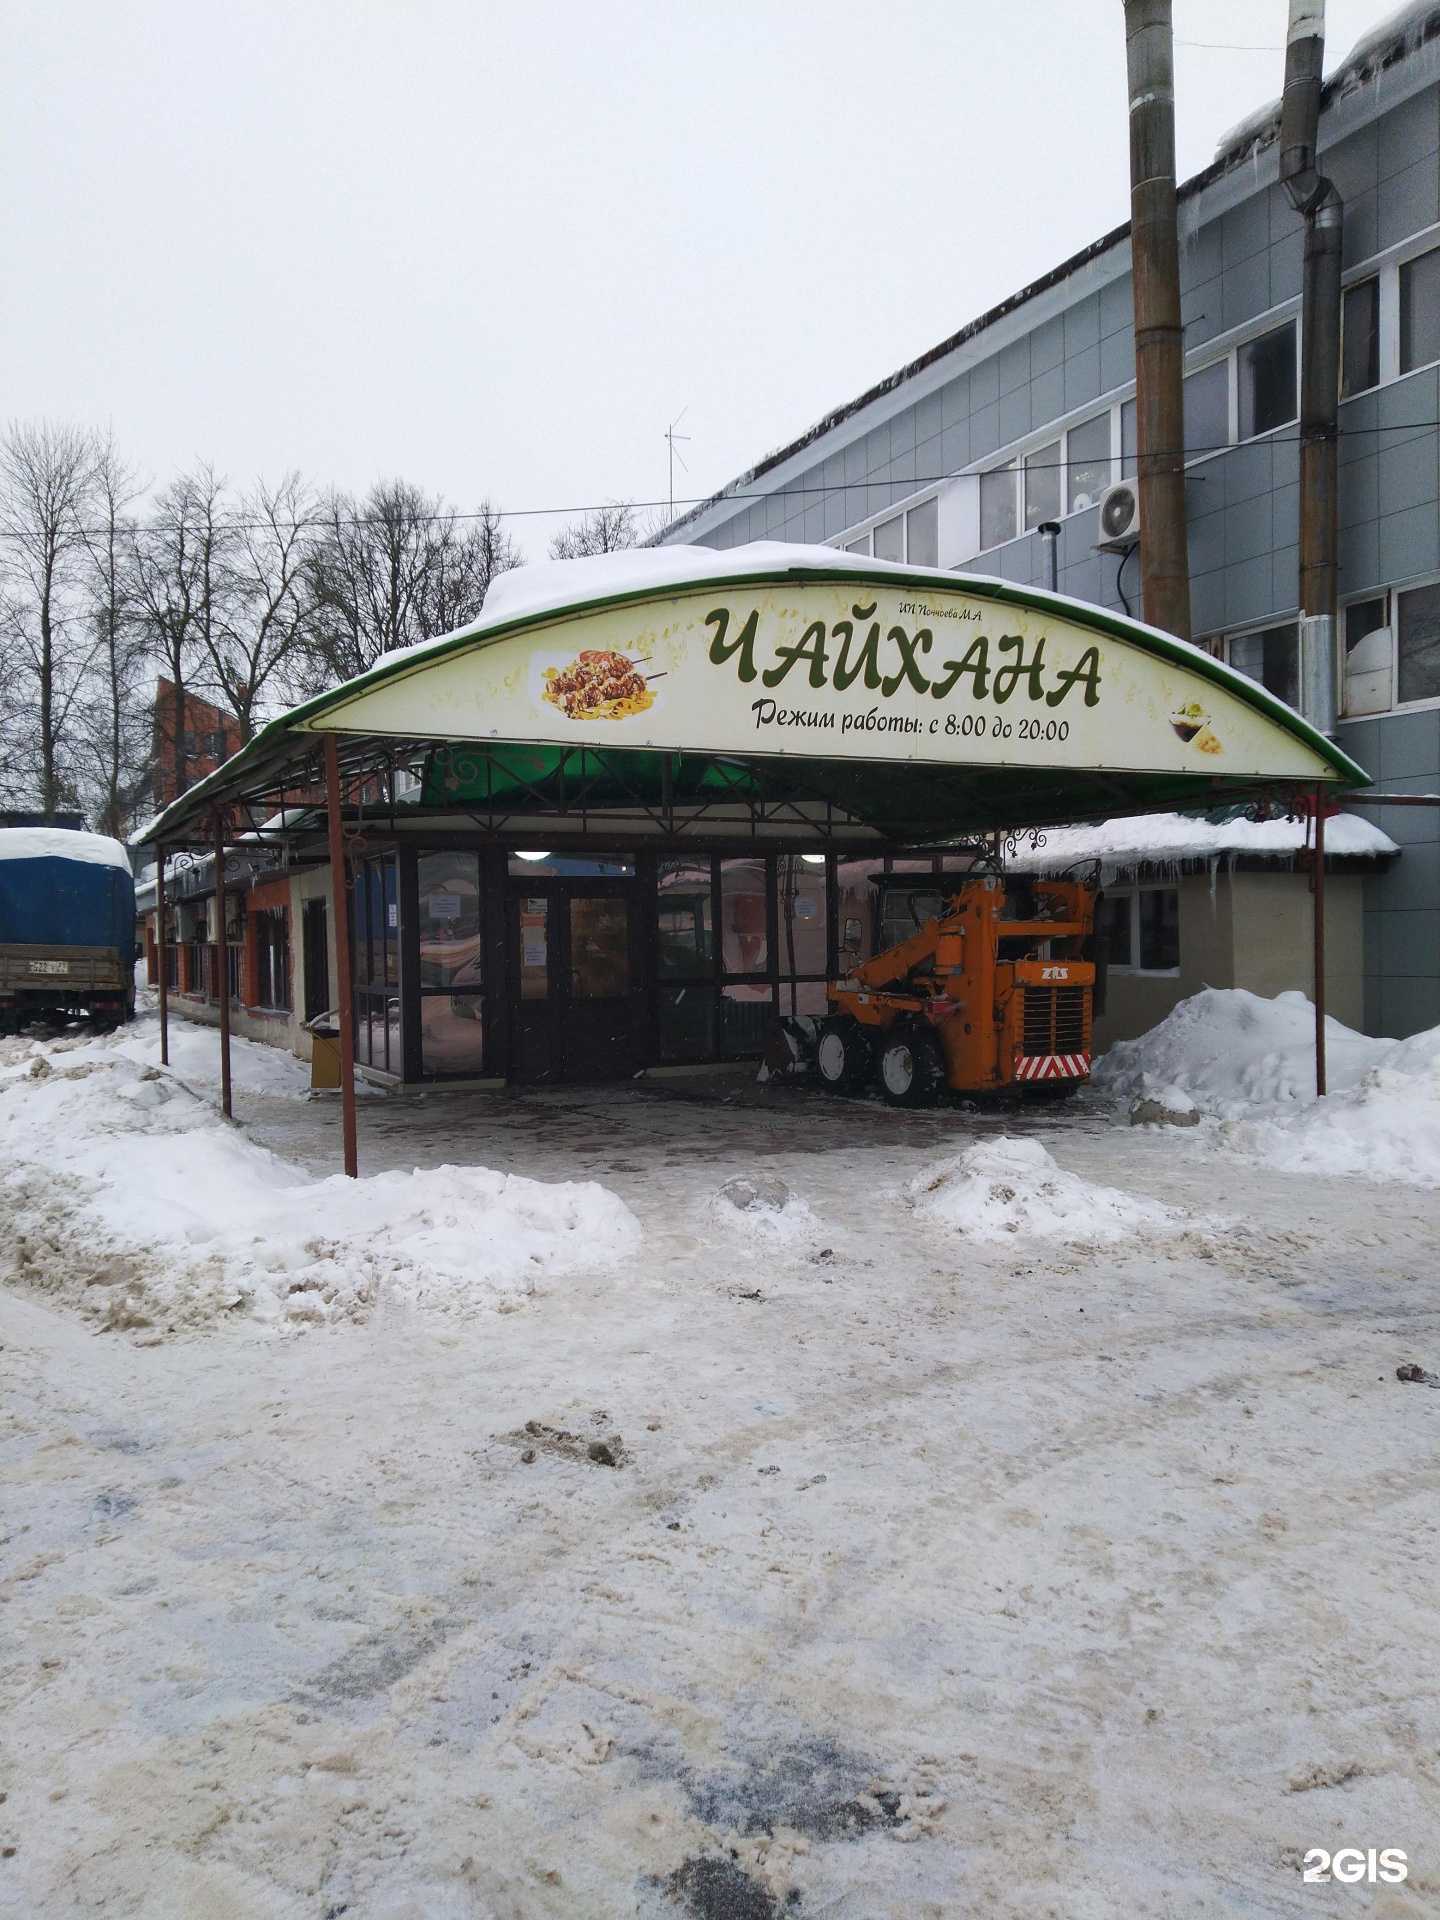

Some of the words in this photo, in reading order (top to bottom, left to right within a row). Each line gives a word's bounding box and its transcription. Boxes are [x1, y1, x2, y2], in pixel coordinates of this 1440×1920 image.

[899, 602, 916, 615] ИП
[705, 602, 1102, 708] ЧАЙХАНА
[751, 698, 835, 729] Режим
[841, 706, 923, 734] работы:
[929, 719, 939, 734] с
[944, 713, 986, 737] 8:00
[992, 715, 1013, 738] до
[1018, 719, 1070, 741] 20:00
